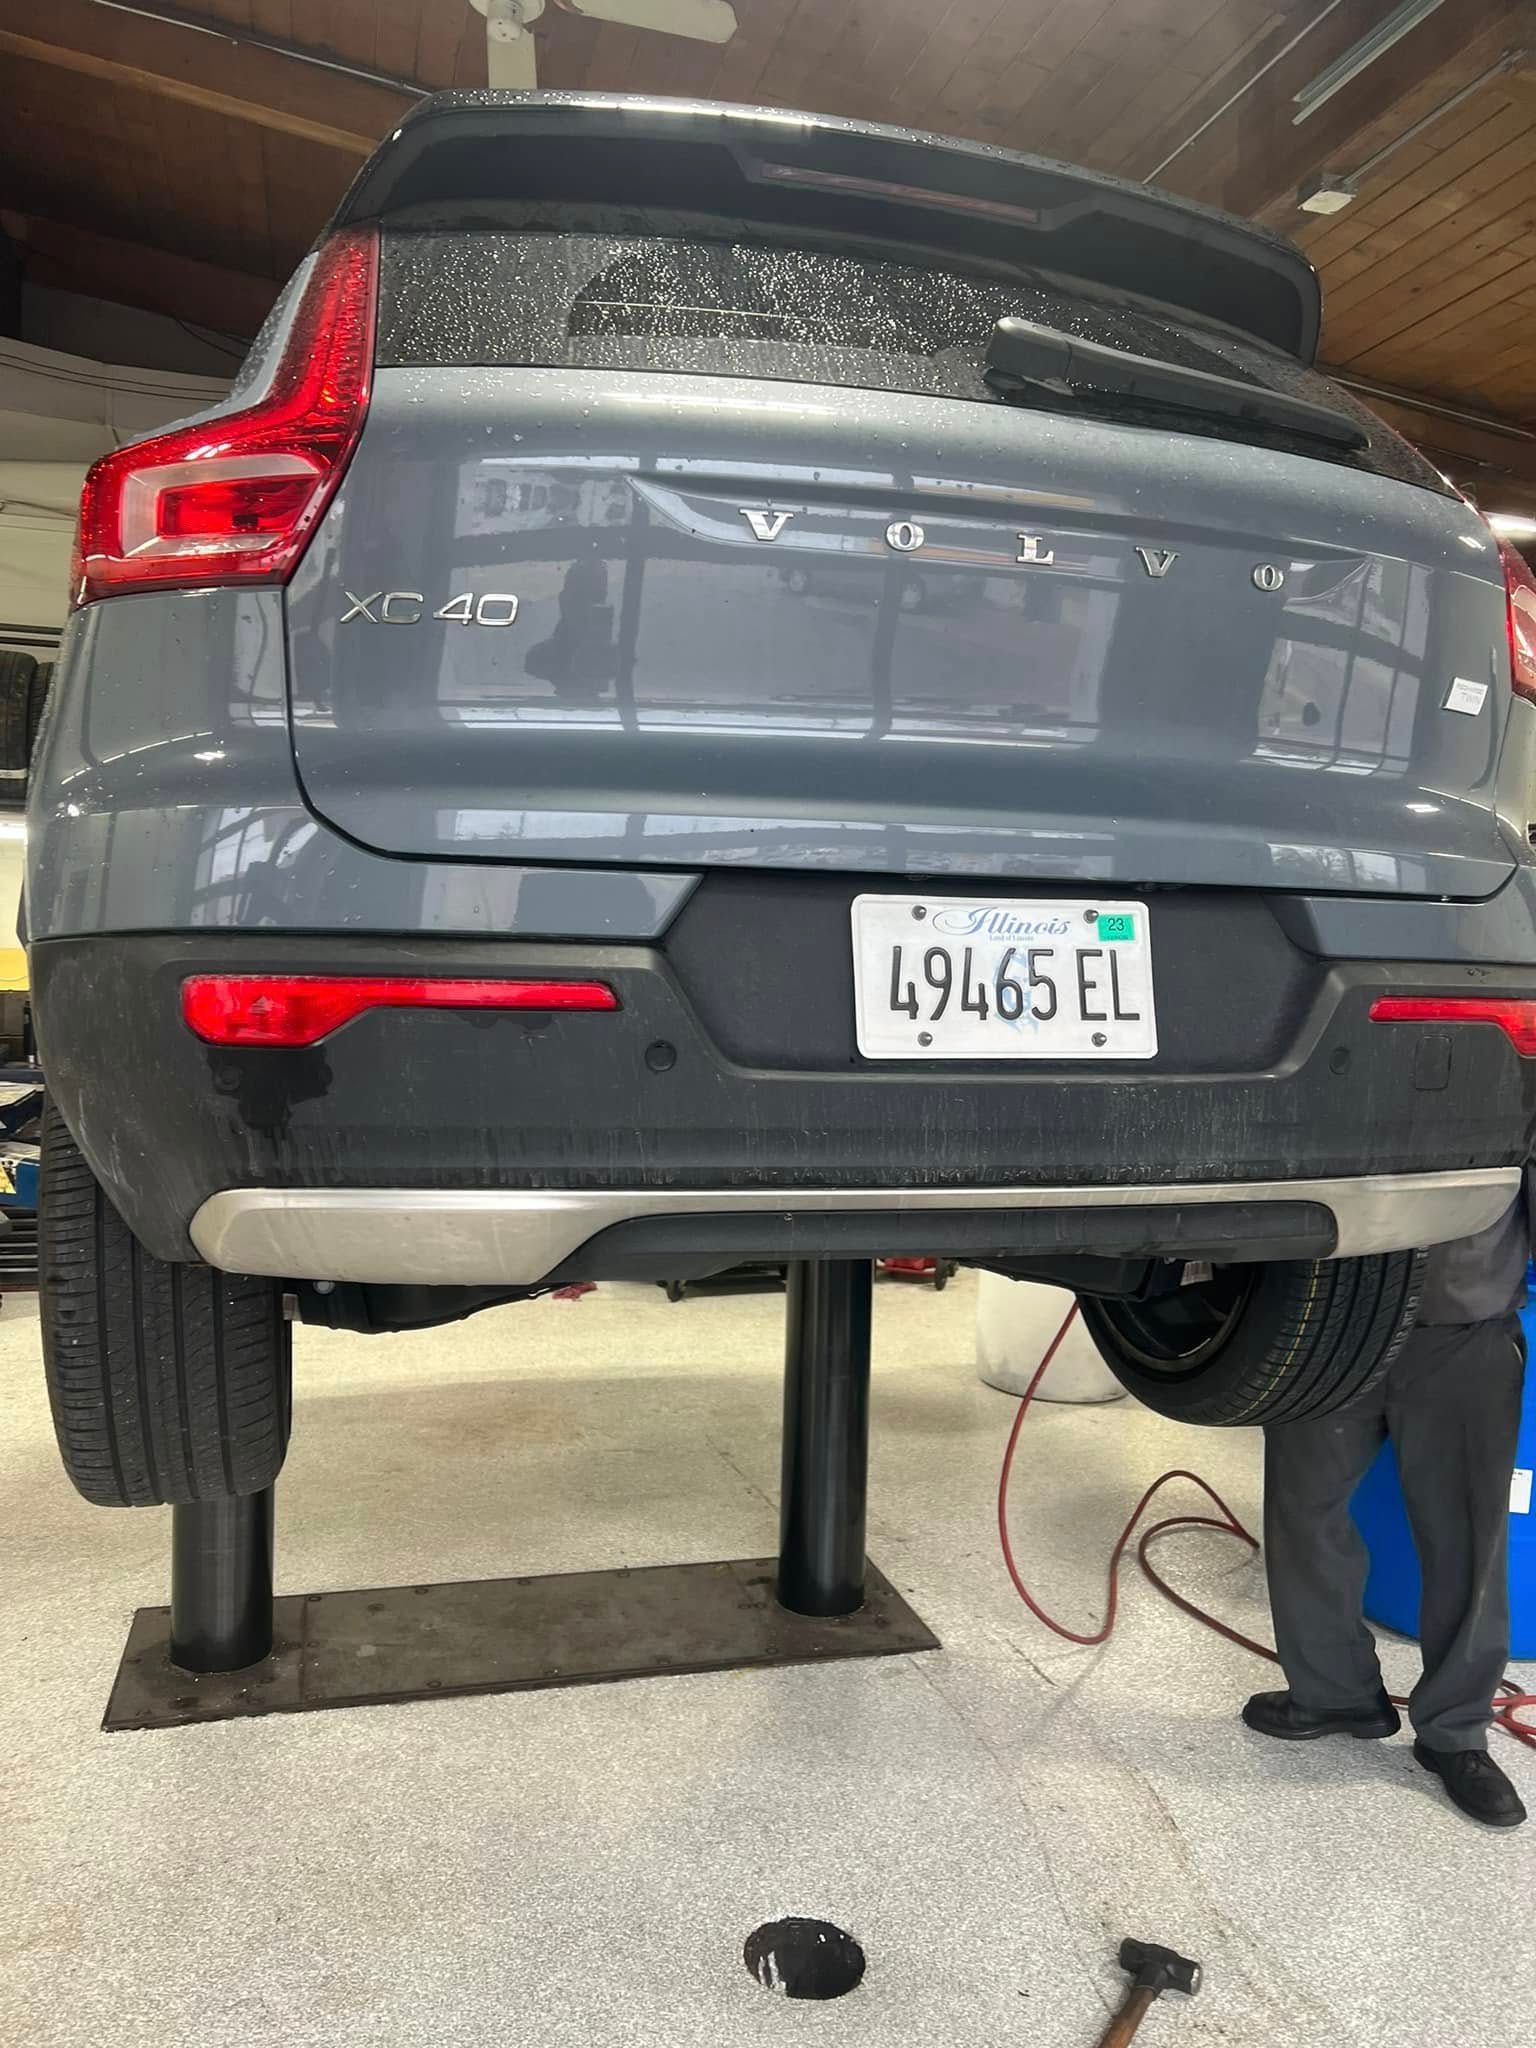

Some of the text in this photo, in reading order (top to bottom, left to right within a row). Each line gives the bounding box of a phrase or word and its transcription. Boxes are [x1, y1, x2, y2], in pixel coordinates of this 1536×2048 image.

[738, 508, 1285, 593] VOLVO
[339, 591, 519, 626] XC 40
[932, 906, 1071, 936] Illinois
[1107, 917, 1125, 931] 23
[889, 945, 1140, 1021] 49465 EL
